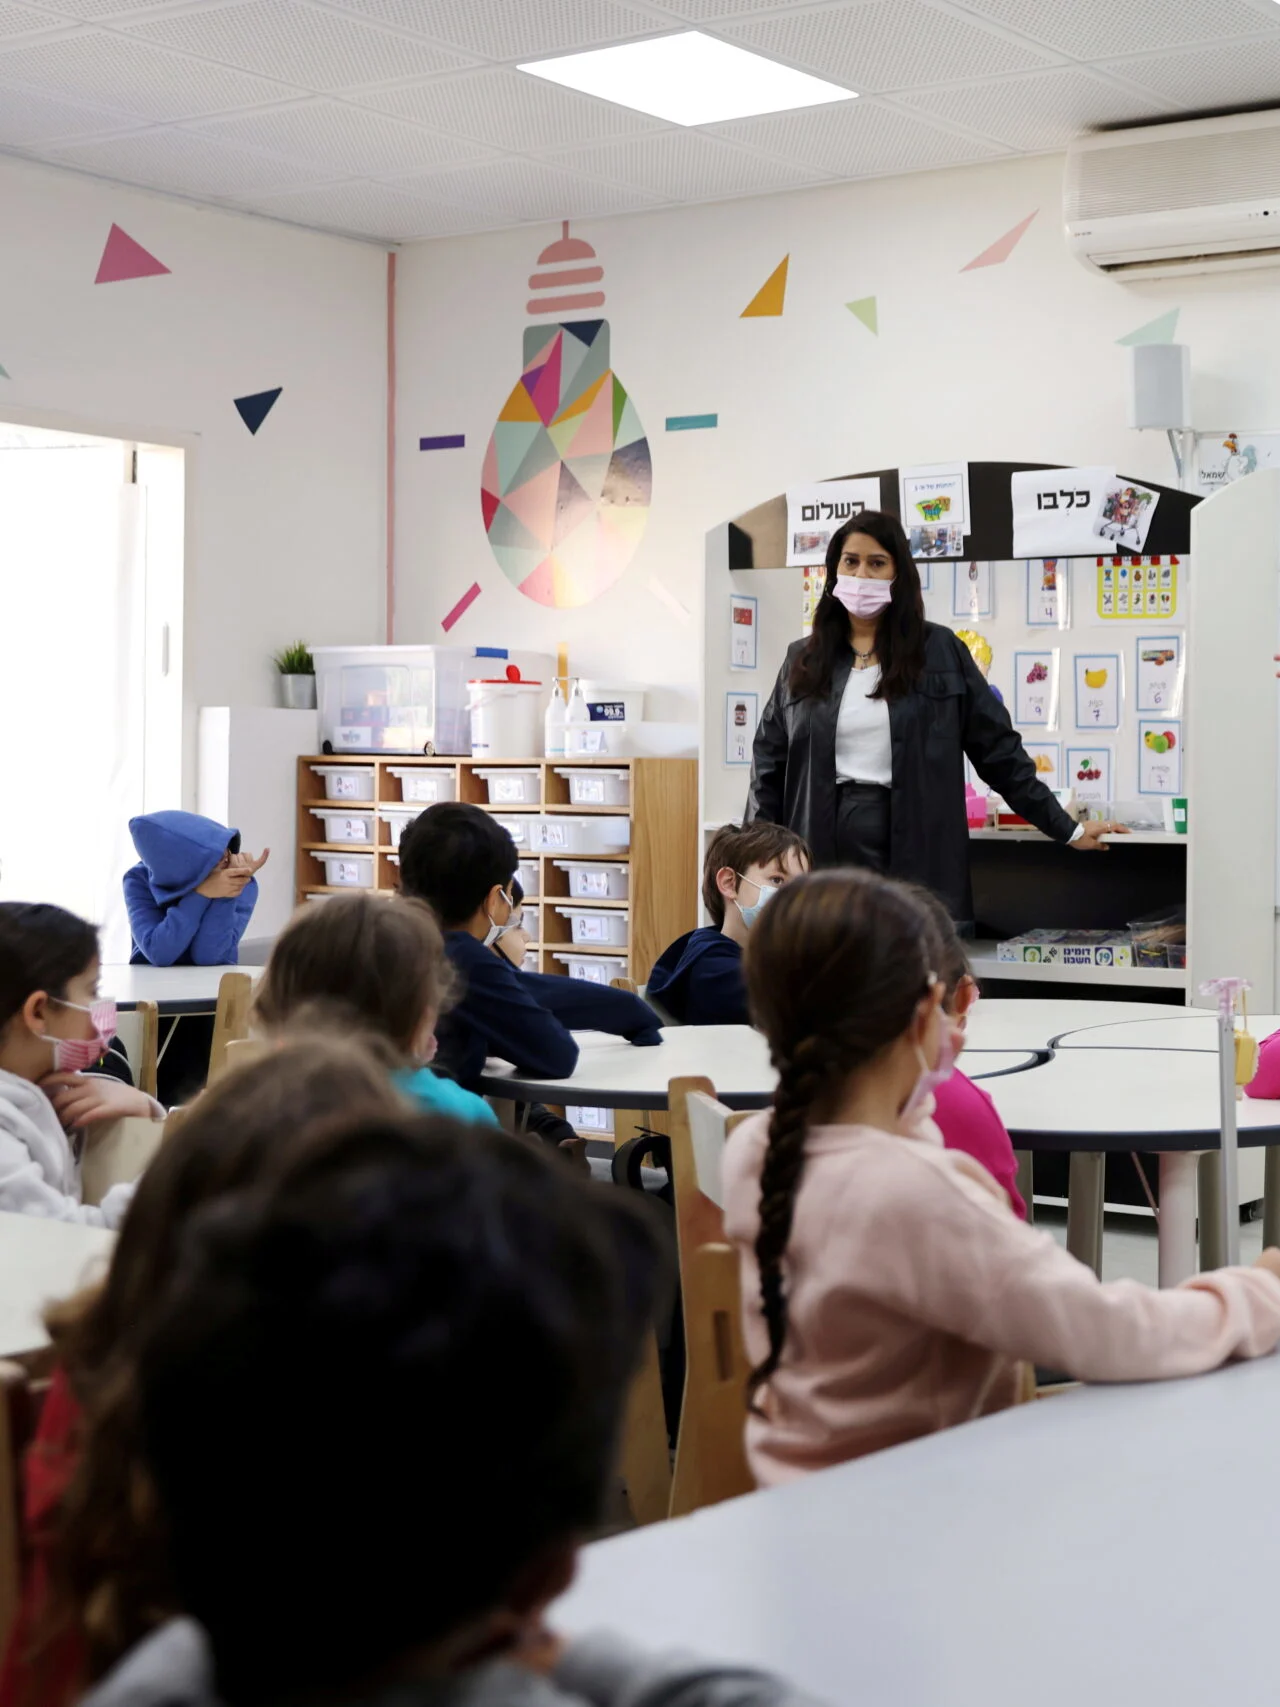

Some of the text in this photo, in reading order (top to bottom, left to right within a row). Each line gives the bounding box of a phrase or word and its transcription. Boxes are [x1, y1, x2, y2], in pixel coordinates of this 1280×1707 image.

[1154, 692, 1162, 704] 6
[1034, 705, 1042, 716] 9
[1092, 709, 1100, 721] 7
